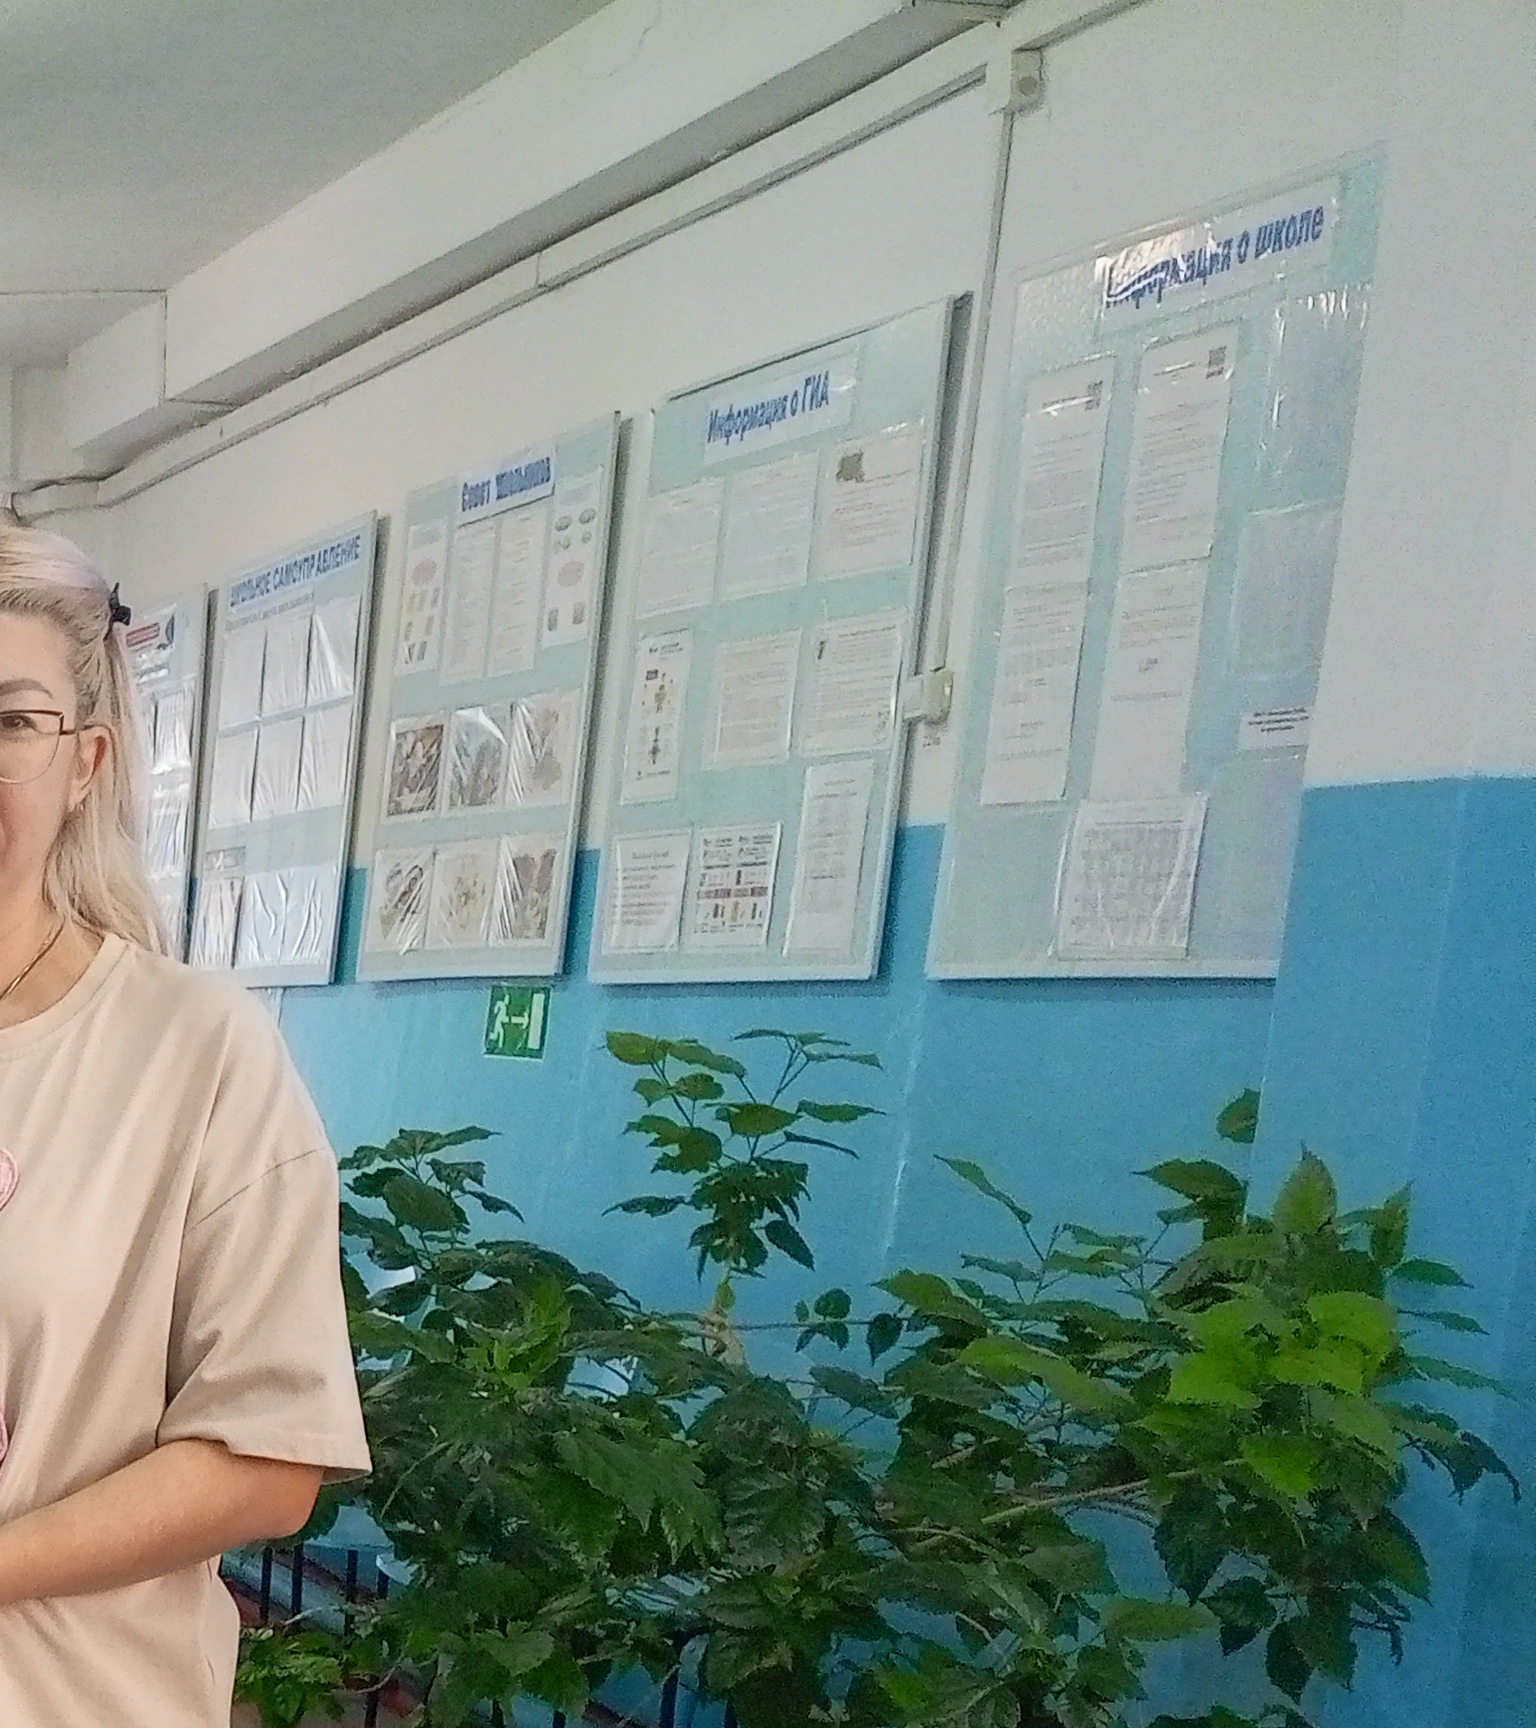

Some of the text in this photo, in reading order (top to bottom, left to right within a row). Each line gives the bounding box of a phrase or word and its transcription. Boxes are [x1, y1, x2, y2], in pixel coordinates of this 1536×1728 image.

[1236, 230, 1251, 264] о
[1254, 205, 1325, 260] школе
[707, 370, 830, 446] Информация о ГИА
[272, 534, 361, 592] САМОУПРАВЛЕНИЕ
